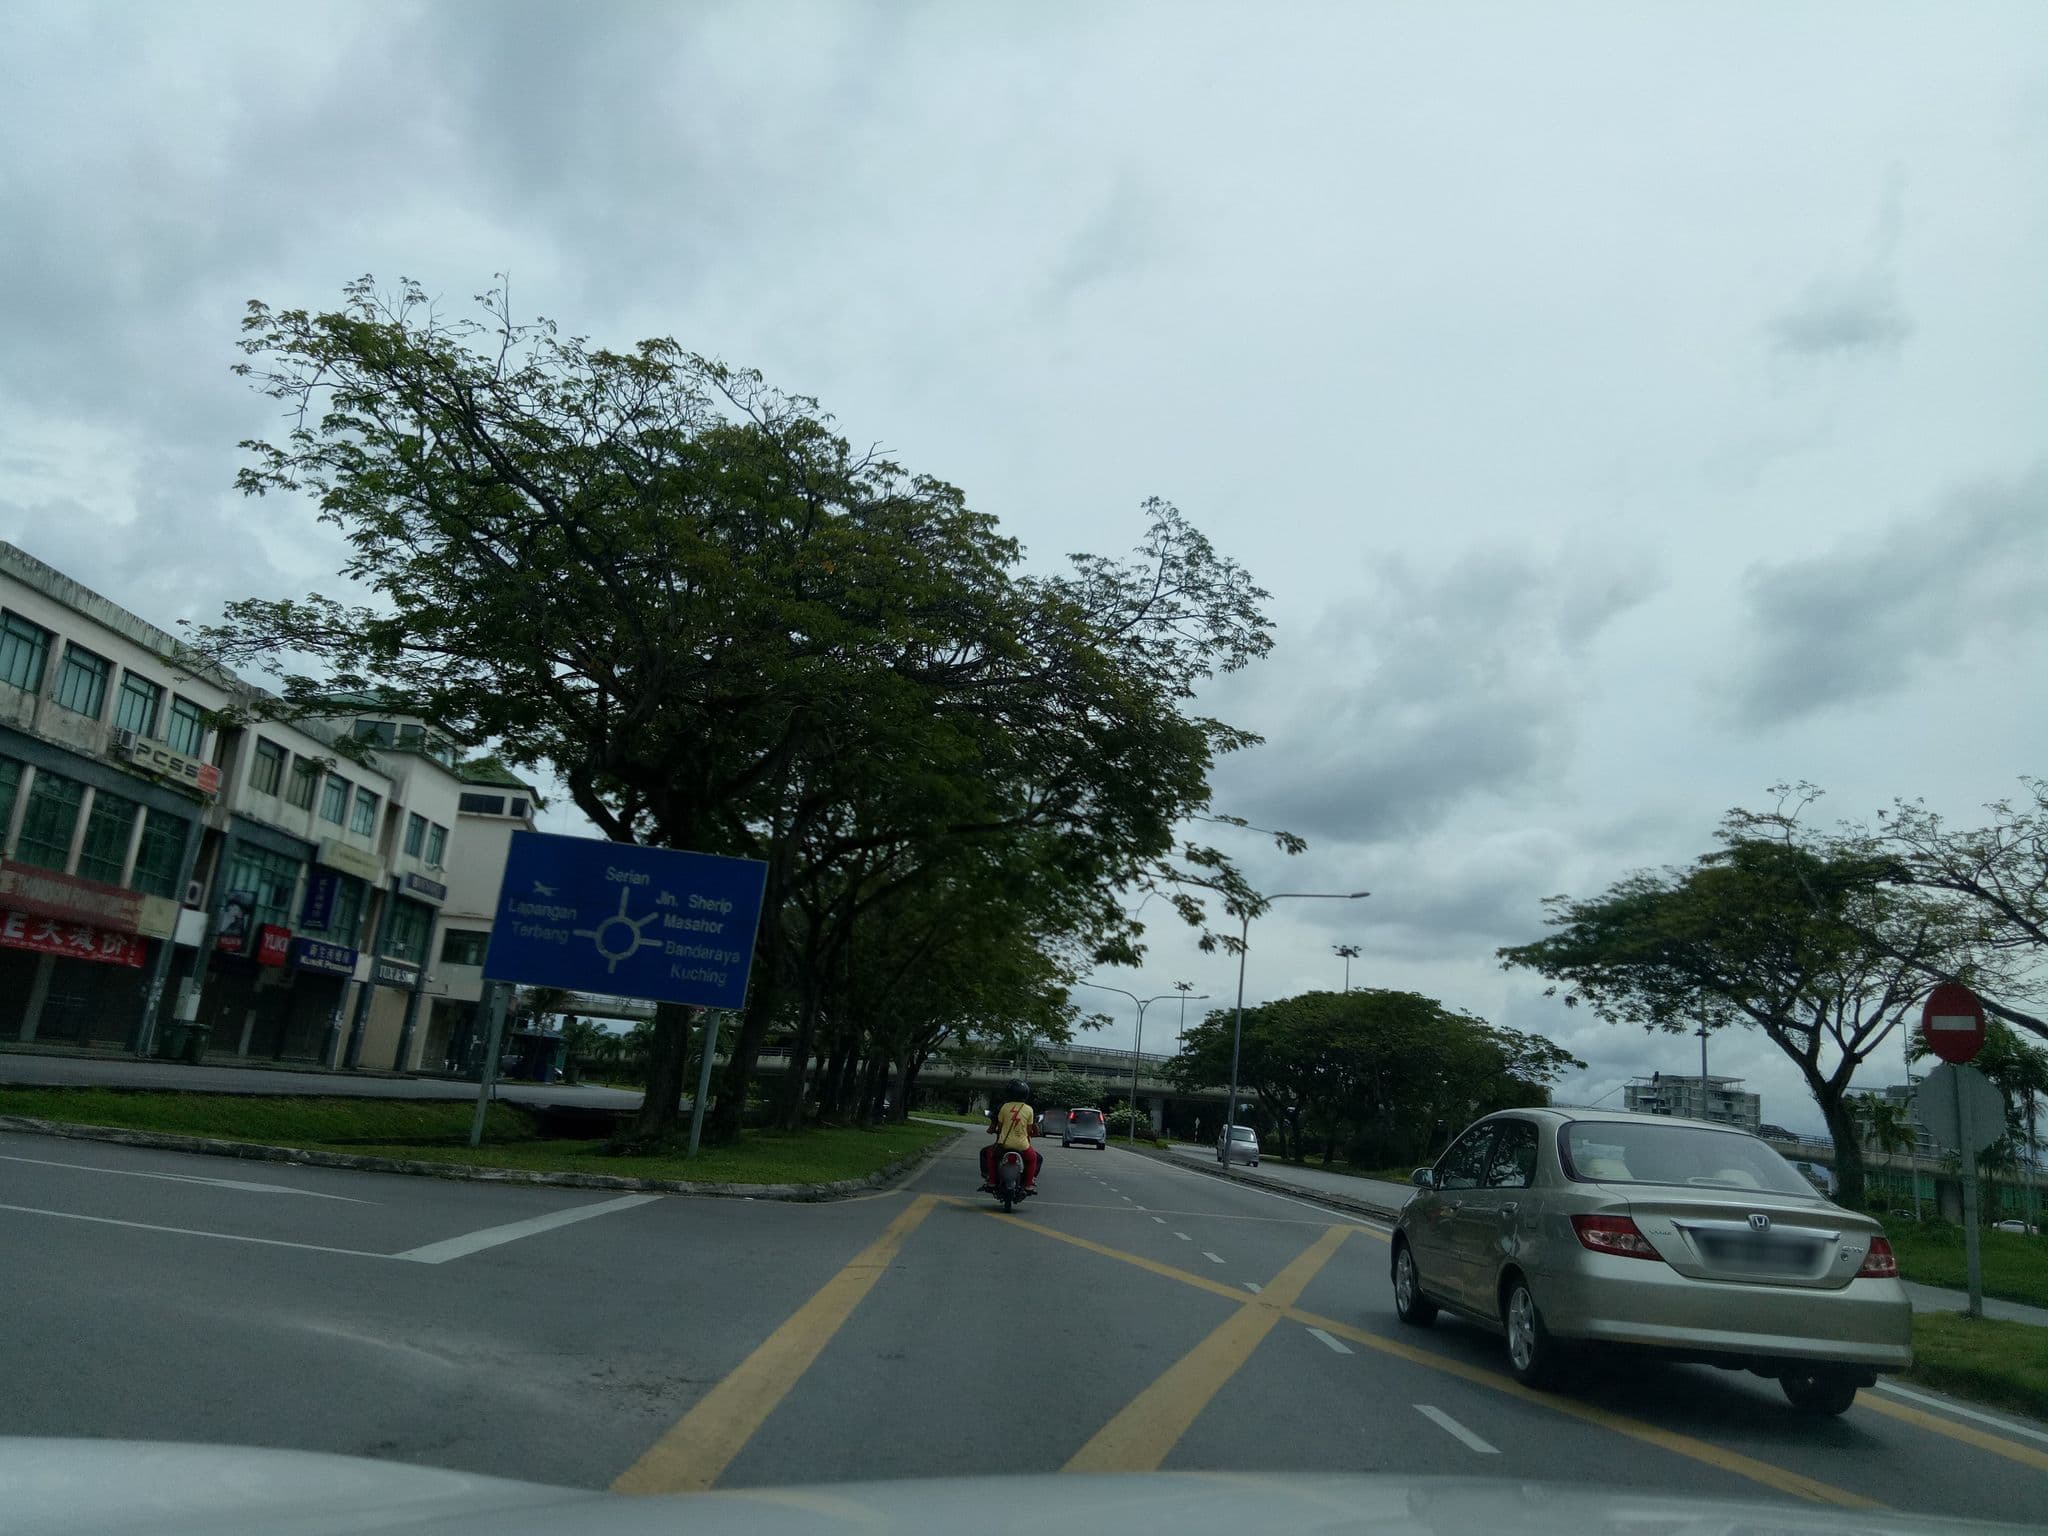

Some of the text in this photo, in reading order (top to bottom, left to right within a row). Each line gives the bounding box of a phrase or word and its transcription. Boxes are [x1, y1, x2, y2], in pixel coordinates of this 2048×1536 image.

[605, 866, 650, 886] Serian
[508, 899, 577, 921] Lapangan
[656, 890, 733, 914] Jln. Sherip
[511, 921, 569, 944] Terbang
[664, 914, 724, 934] Masahor
[665, 940, 741, 966] Bandaraya
[671, 964, 727, 988] Kuching
